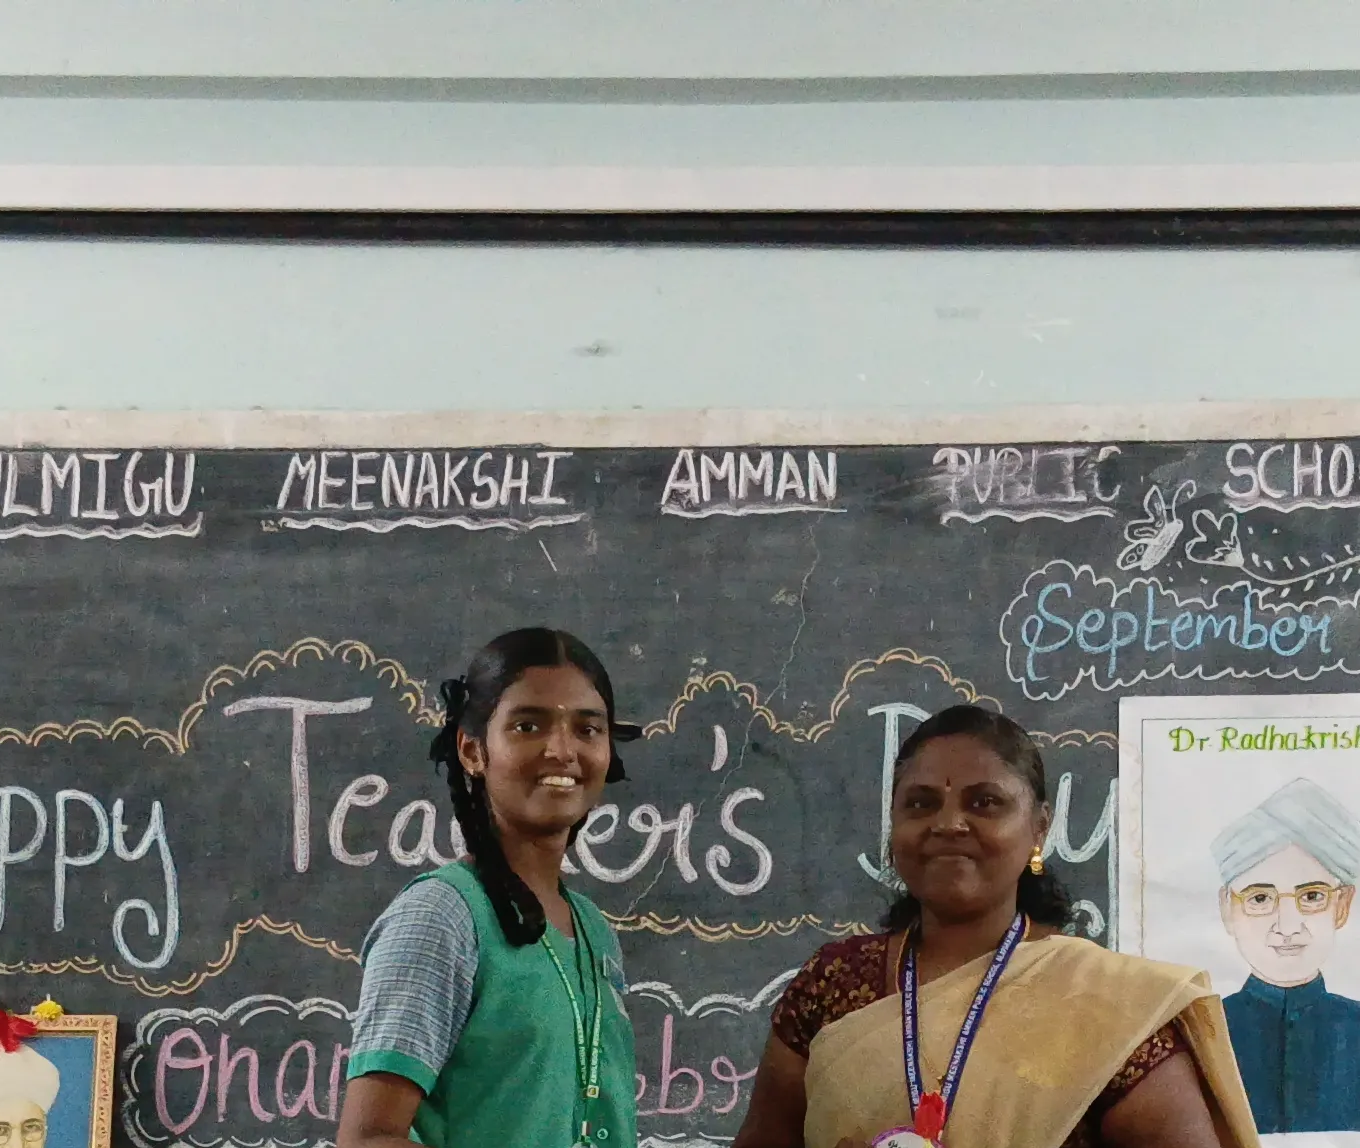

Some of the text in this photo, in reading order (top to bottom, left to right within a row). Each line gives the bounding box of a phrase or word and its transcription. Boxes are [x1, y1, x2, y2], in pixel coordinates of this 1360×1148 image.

[277, 450, 573, 511] MEENAKSHI
[662, 447, 838, 504] AMMAN
[933, 445, 1122, 504] PUBLIC
[1021, 583, 1331, 682] September
[223, 696, 773, 896] Teaer's
